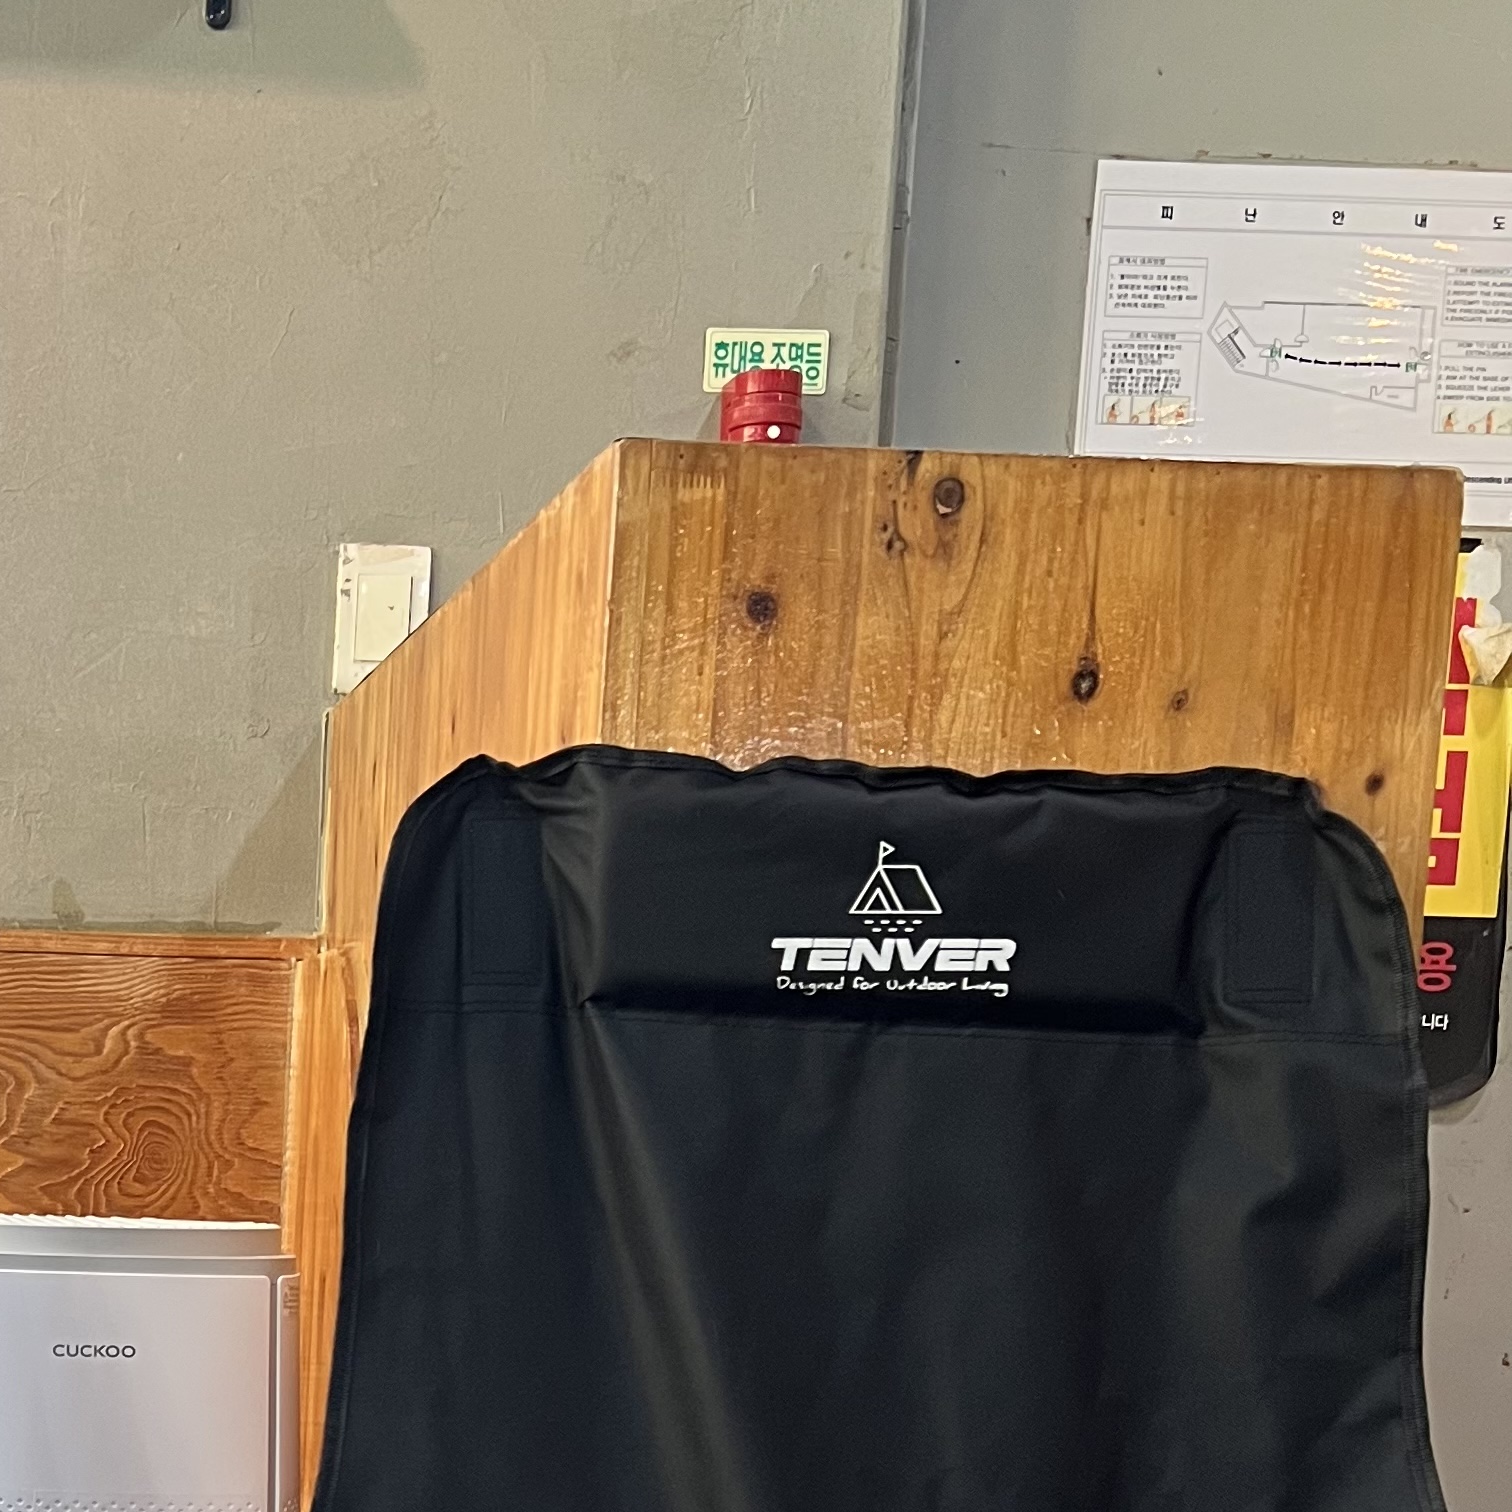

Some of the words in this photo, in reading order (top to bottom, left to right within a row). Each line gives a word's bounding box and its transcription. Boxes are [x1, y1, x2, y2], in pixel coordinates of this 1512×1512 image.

[771, 937, 1018, 972] TENVER
[852, 976, 881, 992] for
[51, 1343, 137, 1359] CUCKOO
